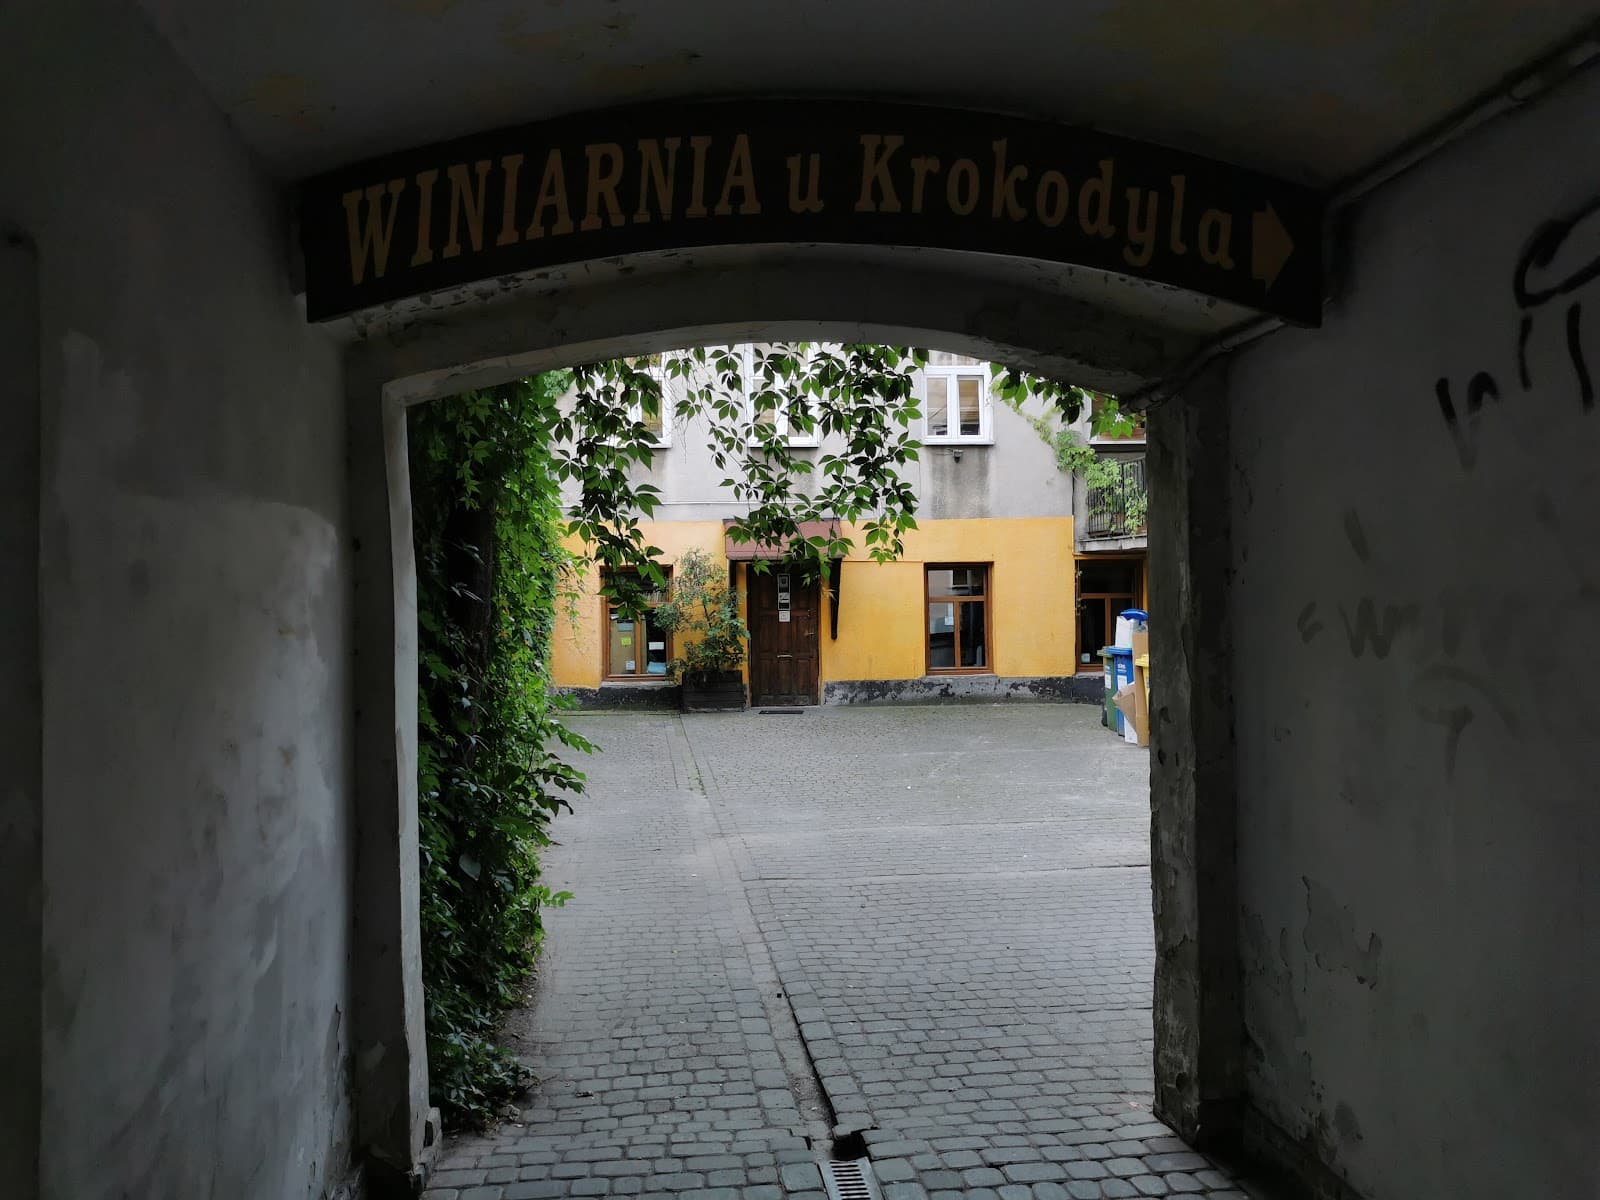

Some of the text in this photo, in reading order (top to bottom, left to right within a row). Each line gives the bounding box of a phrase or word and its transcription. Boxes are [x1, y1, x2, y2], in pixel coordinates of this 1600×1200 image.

[341, 132, 1235, 286] WINIARNIA u Krokodyla
